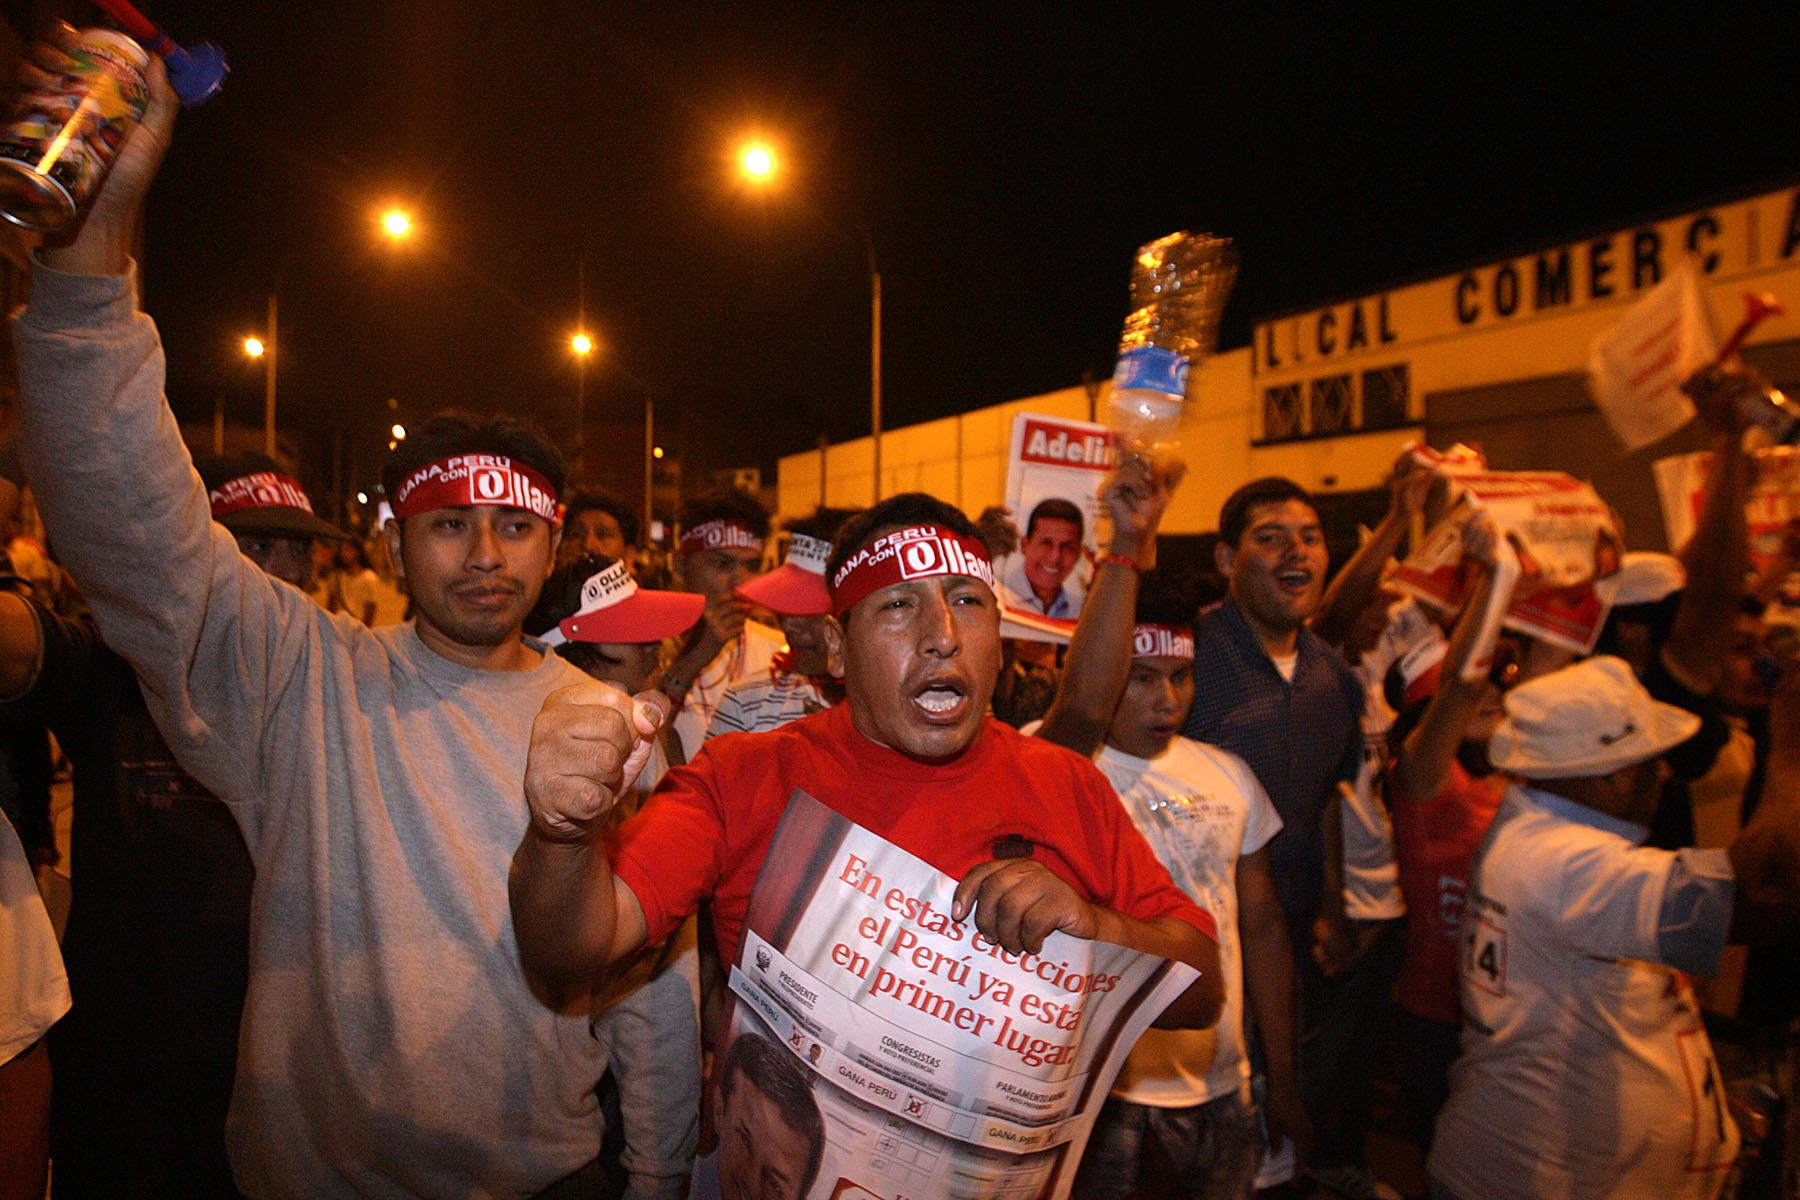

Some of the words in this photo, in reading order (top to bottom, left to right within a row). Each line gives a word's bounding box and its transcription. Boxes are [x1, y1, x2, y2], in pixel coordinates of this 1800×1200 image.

[1266, 294, 1397, 367] LCAL
[399, 464, 443, 502] GANA
[440, 466, 468, 483] CON
[834, 550, 870, 588] GANA
[868, 546, 894, 566] CON
[839, 853, 882, 899] En
[884, 887, 968, 942] estas
[858, 915, 890, 947] el
[889, 926, 972, 987] Perú
[969, 970, 1015, 1007] ya
[779, 970, 818, 1005] PRESIDENTE
[831, 942, 873, 980] en
[868, 965, 994, 1037] primer
[881, 1035, 941, 1068] CONGRESISTAS
[839, 1066, 866, 1087] GANA
[868, 1082, 898, 1100] PERÚ
[989, 1127, 1017, 1140] GANA
